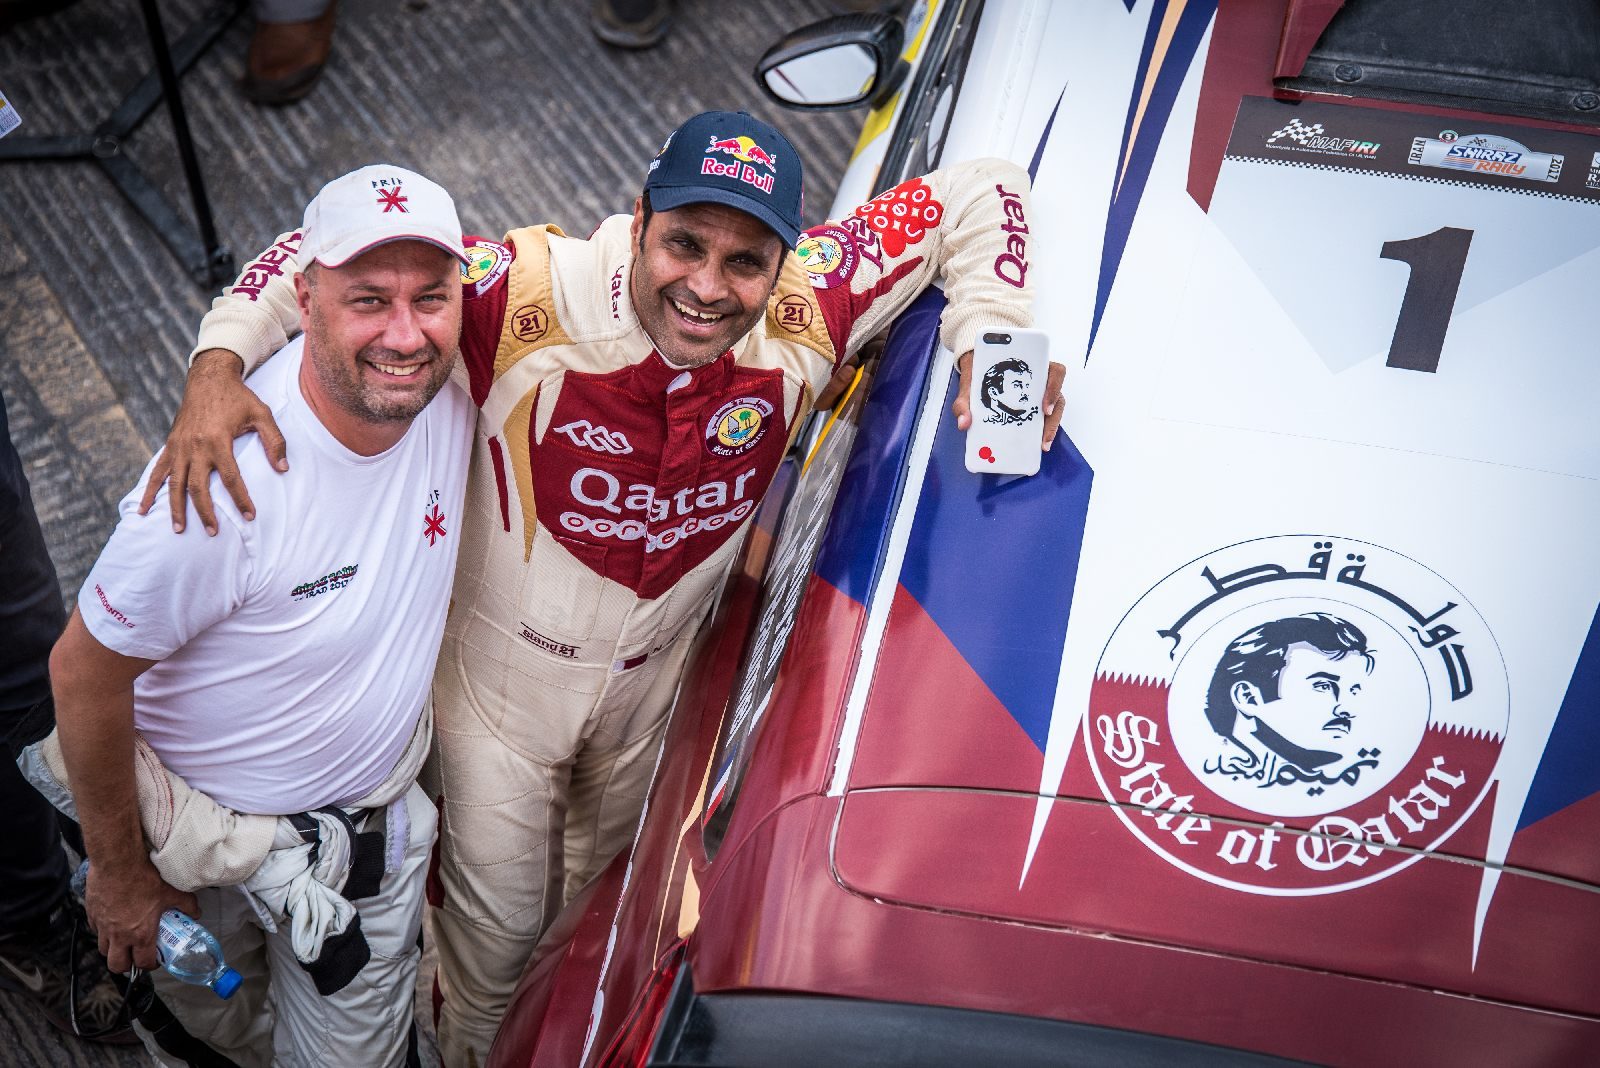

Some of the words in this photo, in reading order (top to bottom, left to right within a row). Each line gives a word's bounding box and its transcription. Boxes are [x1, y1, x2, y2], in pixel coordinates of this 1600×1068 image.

[1307, 136, 1380, 154] MAFIRI
[1409, 138, 1426, 164] IRAN
[1450, 146, 1521, 164] SHIRAZ
[701, 157, 740, 178] Red
[741, 164, 775, 194] Bull
[1547, 155, 1562, 181] 2017
[994, 184, 1029, 288] Qatar
[784, 306, 805, 323] 21
[1379, 226, 1475, 373] 1
[519, 314, 541, 332] 21
[570, 467, 756, 522] Qatar
[1157, 541, 1333, 661] قطر
[1337, 553, 1474, 701] دولة
[1096, 711, 1212, 845] State
[1216, 821, 1286, 871] of
[1296, 755, 1466, 871] Qatar
